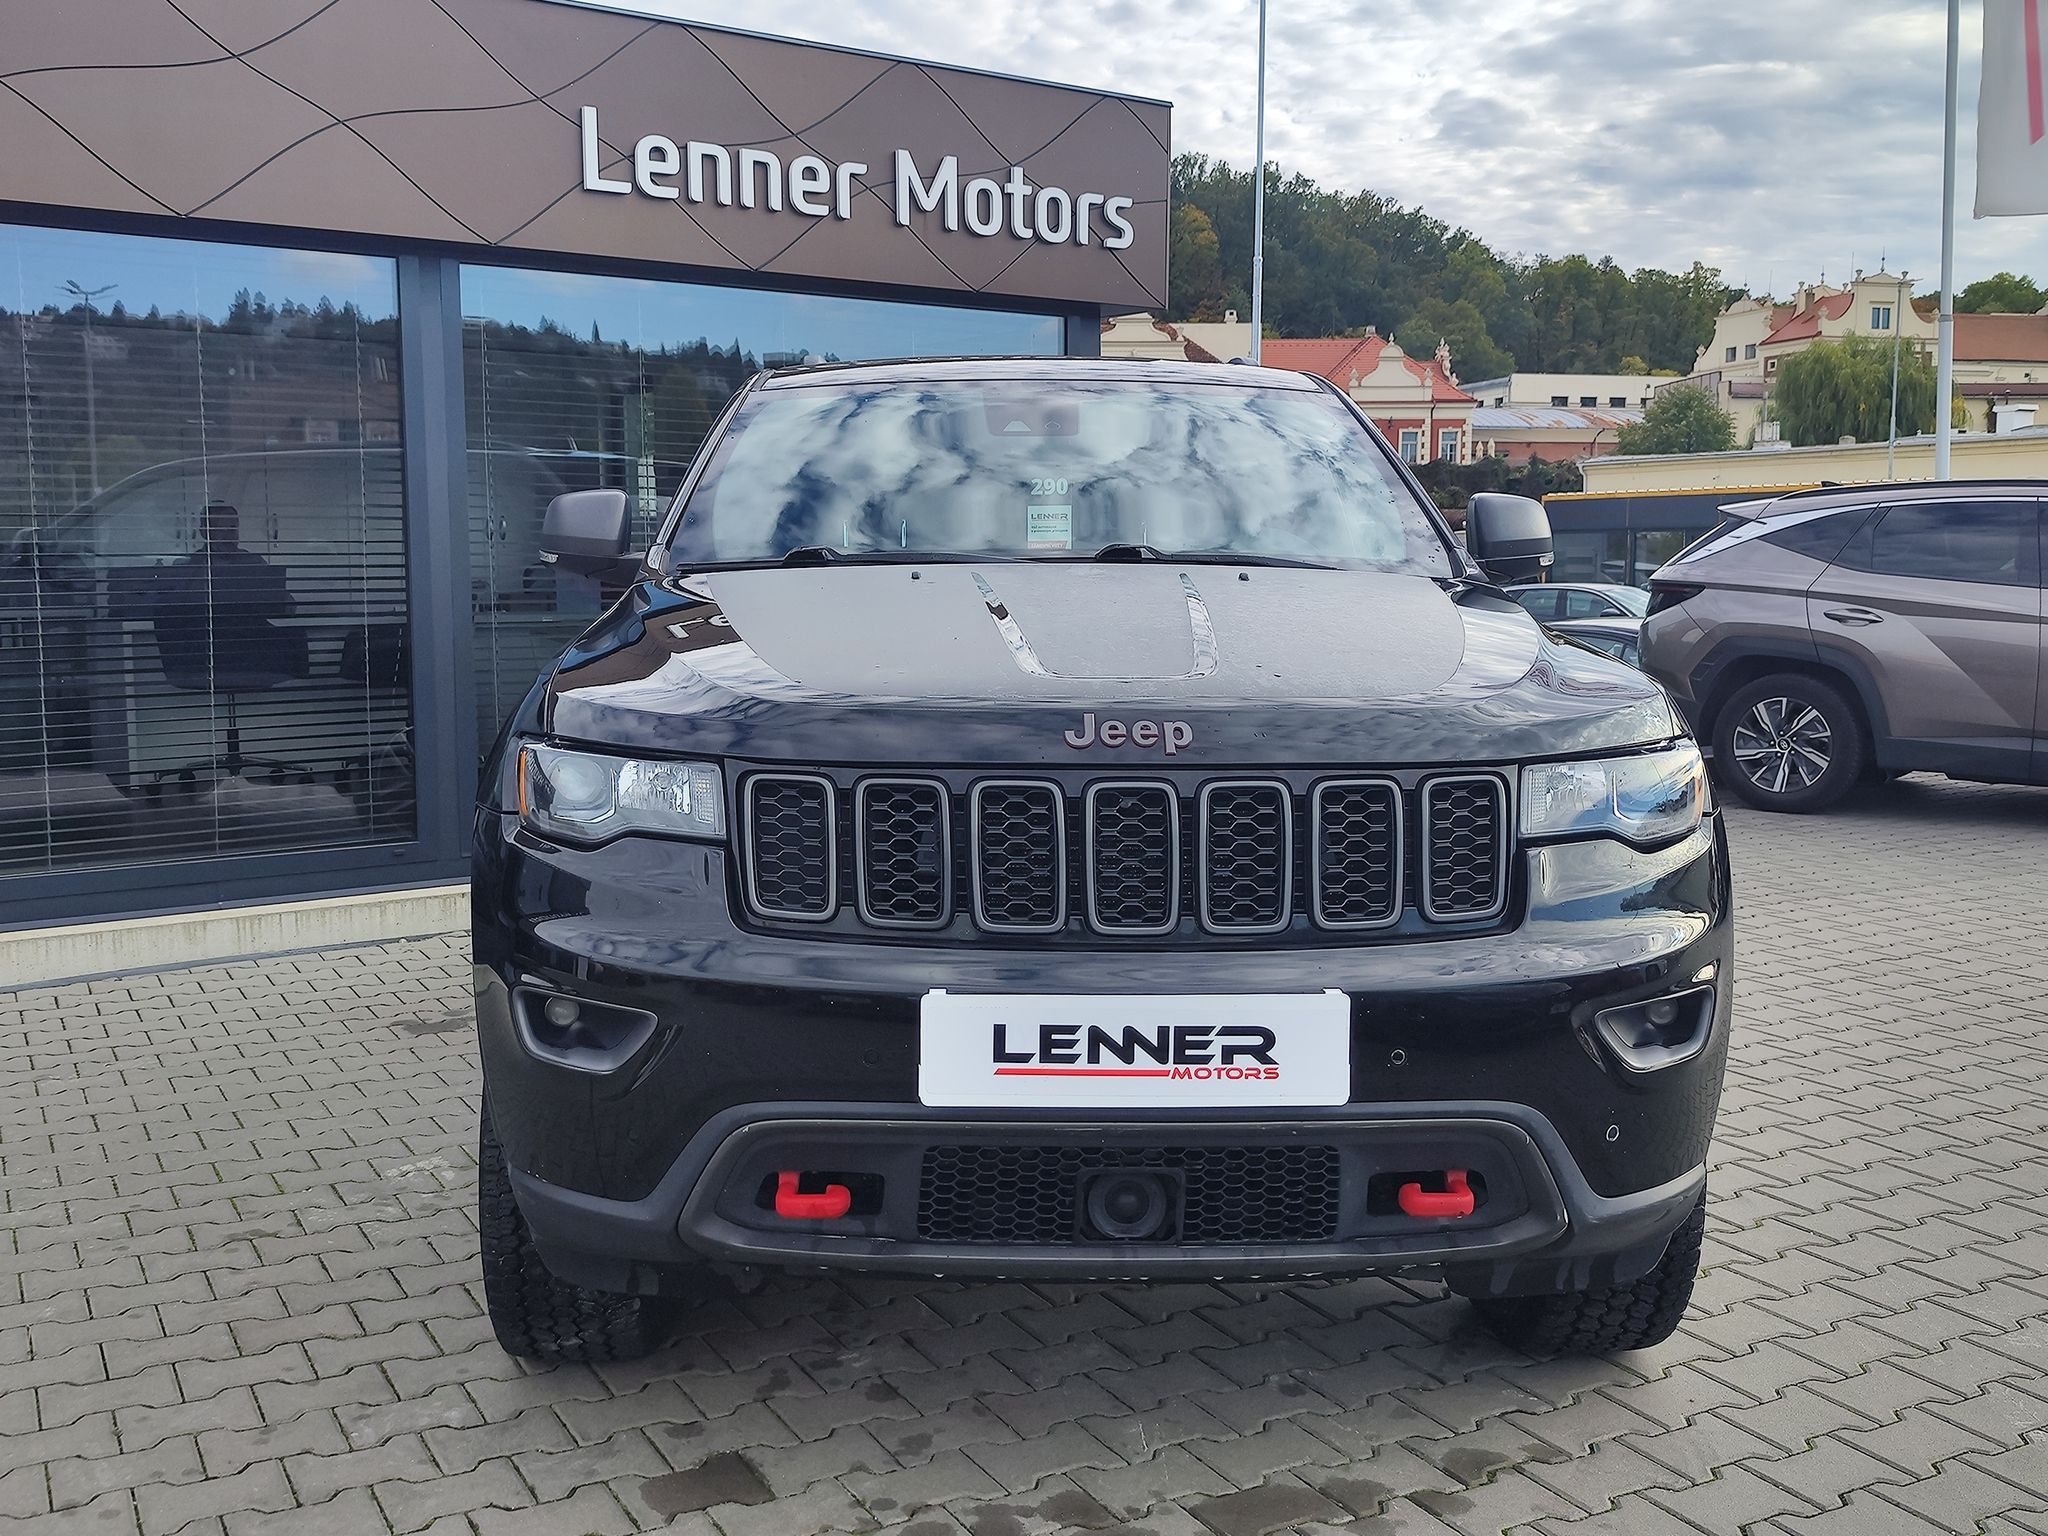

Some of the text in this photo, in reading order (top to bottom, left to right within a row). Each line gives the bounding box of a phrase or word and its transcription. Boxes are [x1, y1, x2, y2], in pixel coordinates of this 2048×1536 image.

[580, 104, 1135, 250] Lenner Motors
[1030, 477, 1069, 496] 290
[1064, 712, 1193, 756] Jeep
[992, 1023, 1280, 1065] LENNER
[1170, 1066, 1281, 1081] MOTORS
